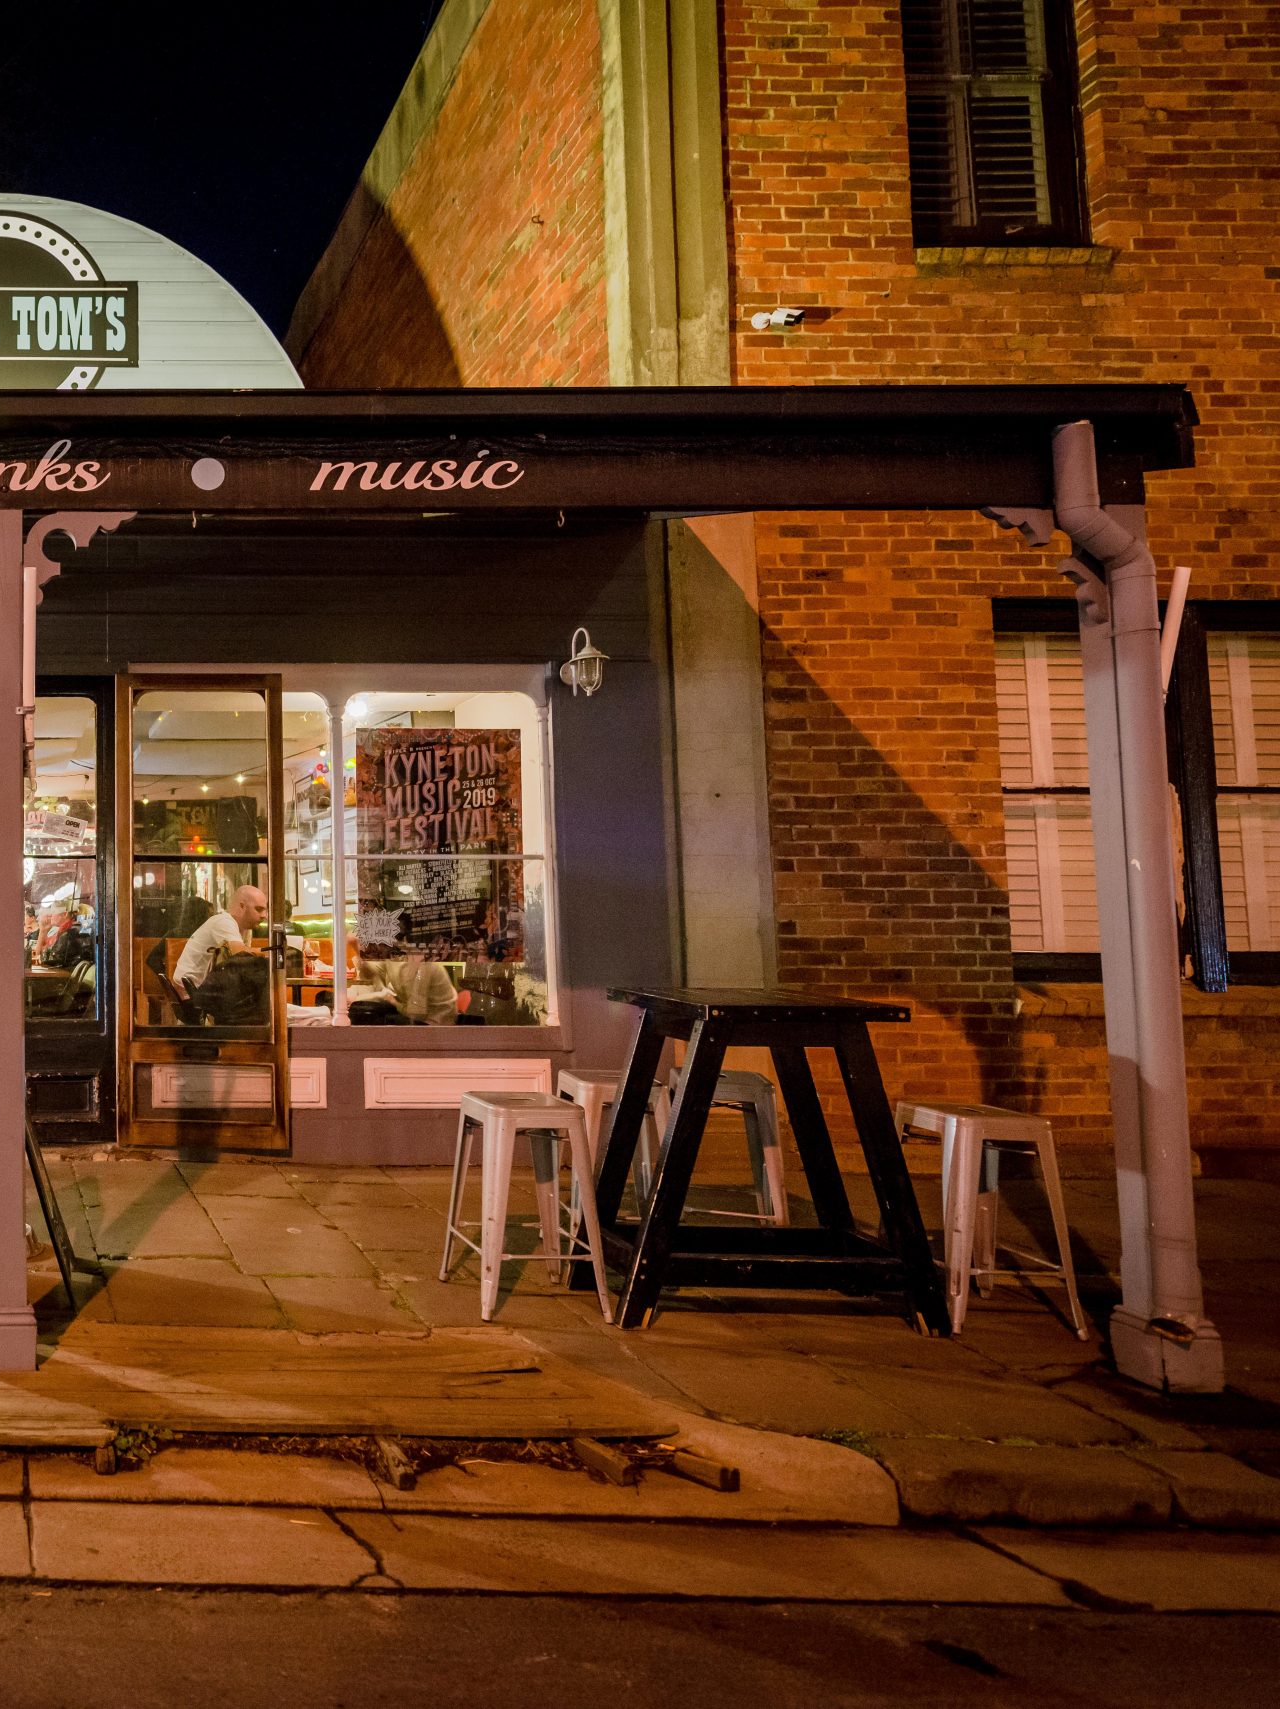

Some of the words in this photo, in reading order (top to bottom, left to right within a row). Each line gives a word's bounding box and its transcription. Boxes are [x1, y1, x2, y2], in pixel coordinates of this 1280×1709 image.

[12, 295, 127, 351] TOM'S
[308, 449, 525, 492] music
[384, 742, 497, 788] KYNETON
[385, 779, 461, 819] MUSIC
[463, 787, 496, 809] 2019
[65, 819, 81, 829] OPEN
[384, 806, 497, 852] FESTIVAL
[460, 841, 487, 851] PARK
